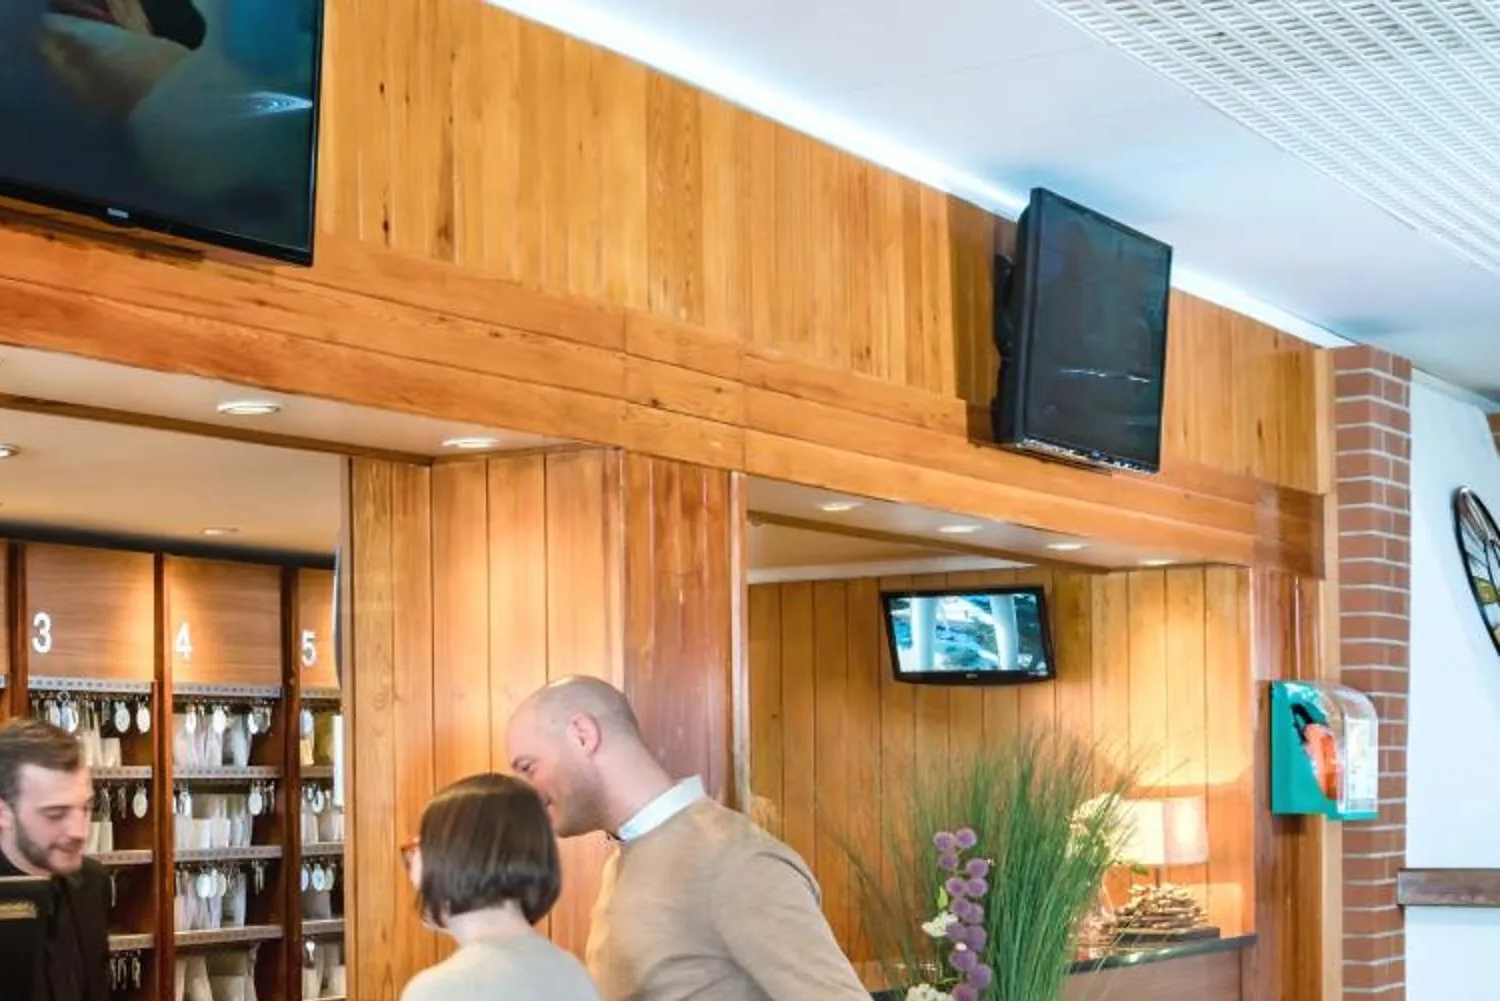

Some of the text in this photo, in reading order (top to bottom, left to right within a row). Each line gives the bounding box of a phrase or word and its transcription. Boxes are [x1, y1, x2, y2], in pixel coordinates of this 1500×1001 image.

[31, 612, 52, 653] 3
[174, 622, 193, 661] 4
[301, 630, 317, 666] 5
